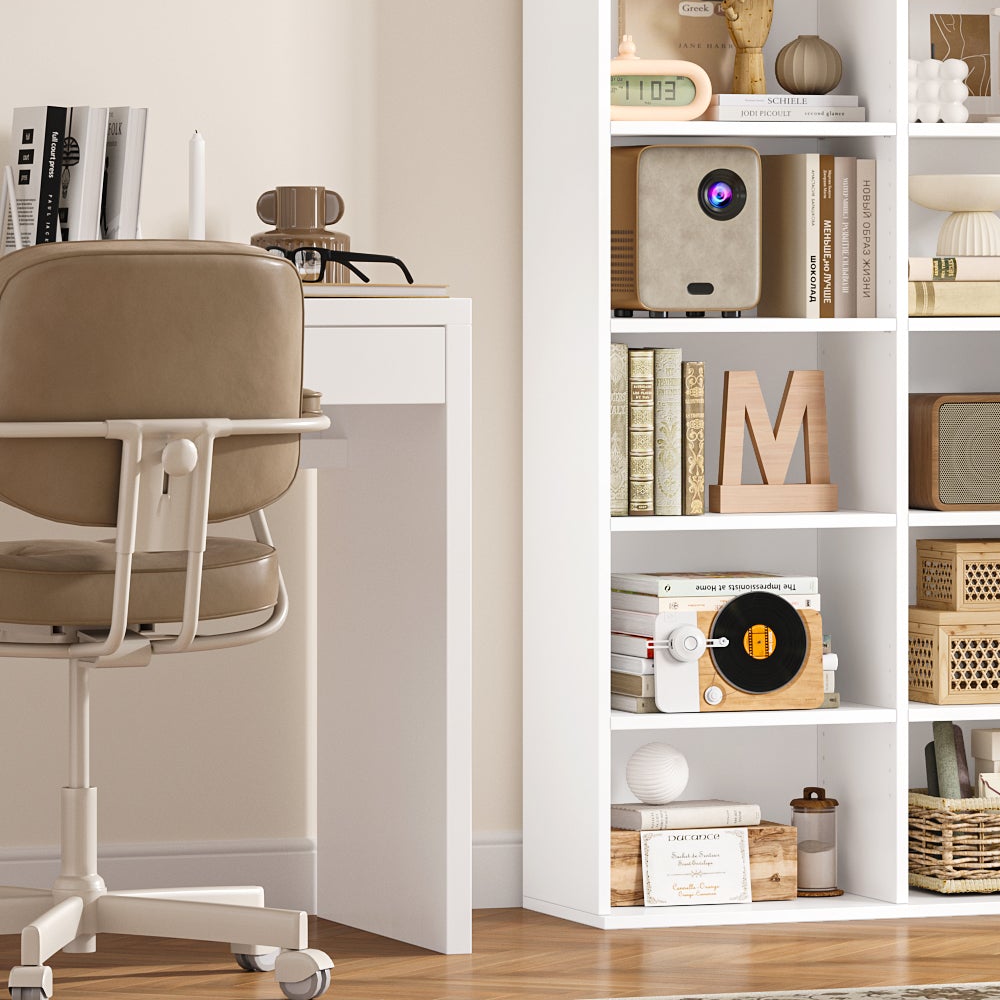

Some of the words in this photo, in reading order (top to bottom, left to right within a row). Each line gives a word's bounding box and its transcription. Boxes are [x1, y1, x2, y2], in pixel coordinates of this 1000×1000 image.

[682, 4, 709, 13] Greek
[767, 97, 808, 105] SCHIELE
[51, 131, 59, 143] full
[107, 122, 122, 136] FOLK
[50, 142, 58, 161] court
[48, 160, 56, 179] press
[862, 179, 872, 219] НОВЫЙ
[862, 221, 871, 256] ОБРАЗ
[809, 255, 817, 303] ШОКОЛАД
[823, 272, 832, 304] ЛУЧШЕ
[862, 258, 871, 299] ЖИЗНИ
[719, 370, 831, 485] M
[728, 583, 781, 591] Impressionists
[783, 583, 796, 591] The
